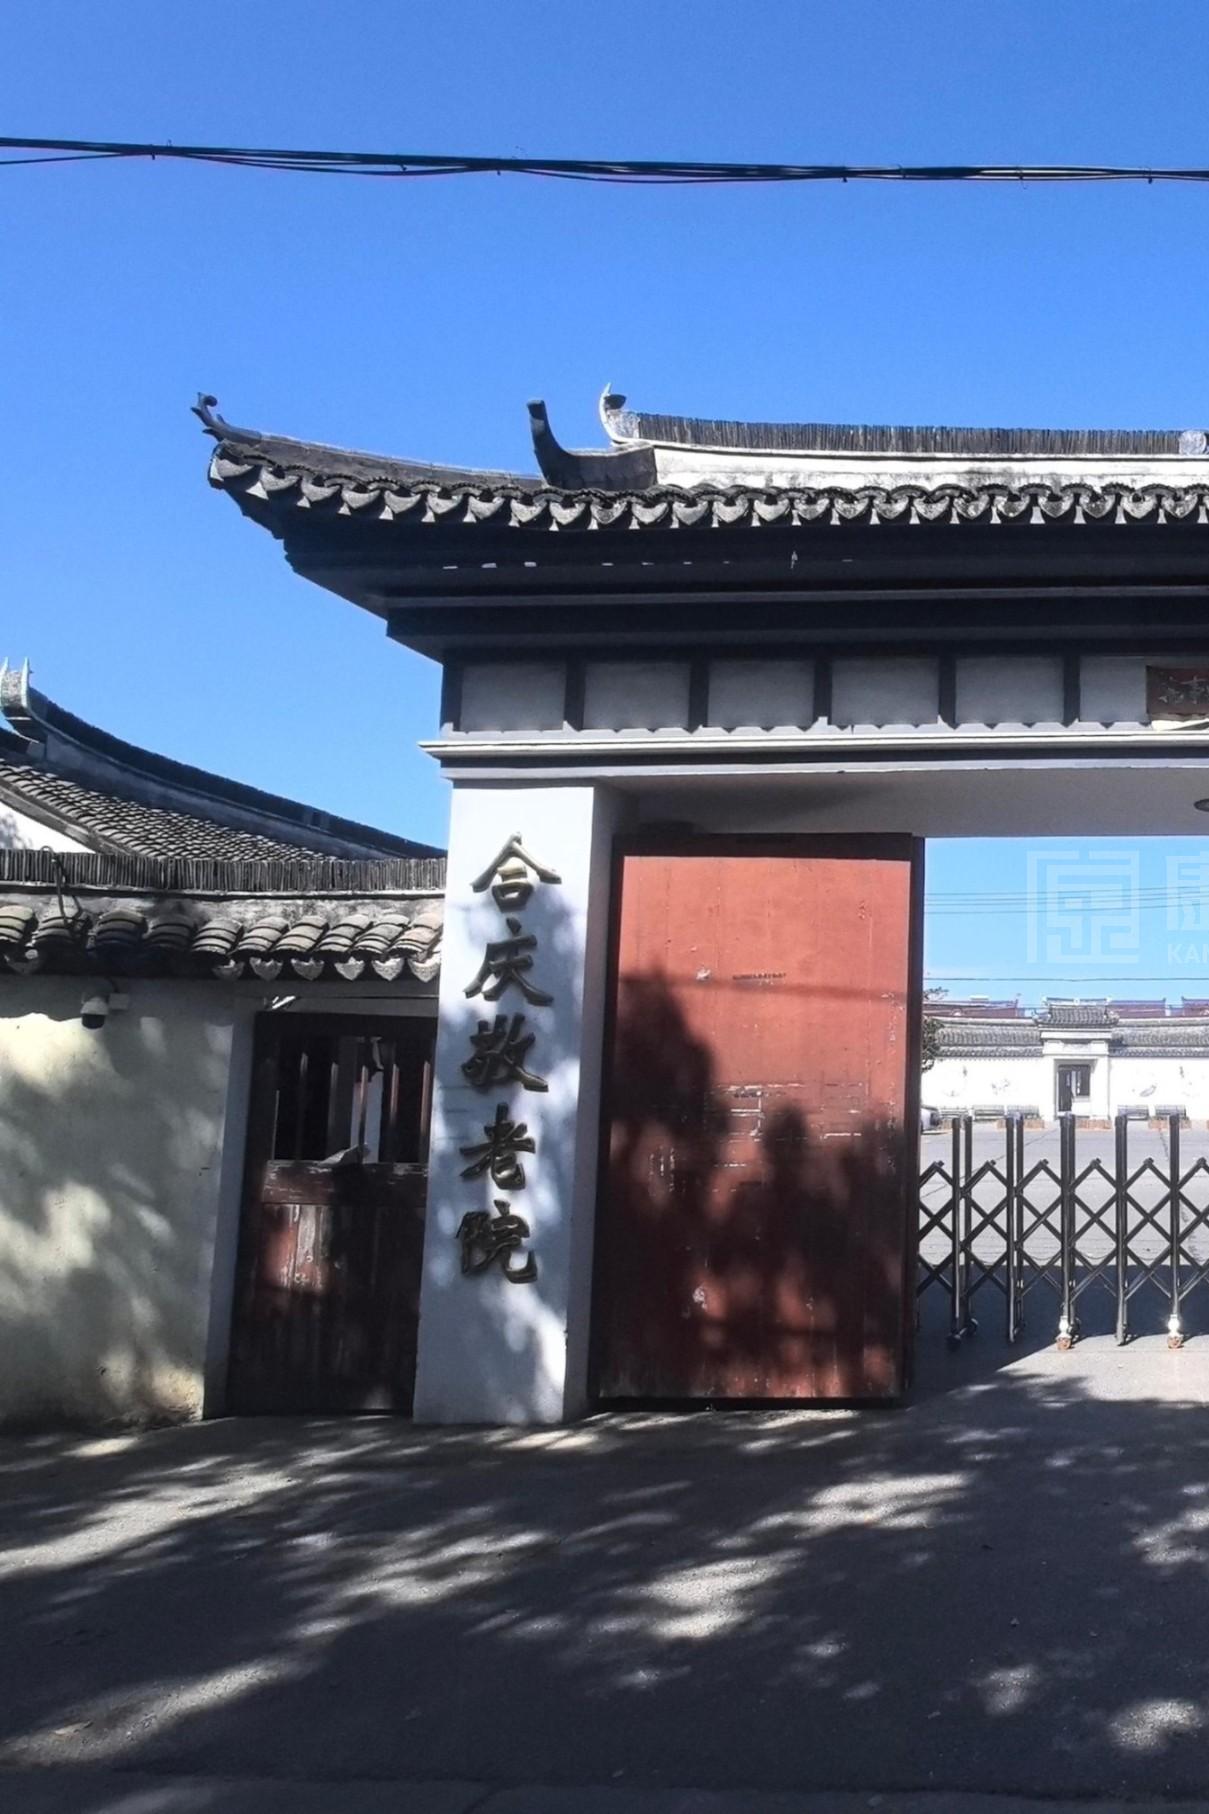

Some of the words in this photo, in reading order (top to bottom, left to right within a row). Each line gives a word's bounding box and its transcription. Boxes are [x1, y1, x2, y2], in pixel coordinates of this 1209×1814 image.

[456, 831, 562, 1284] 合庆敬老院
